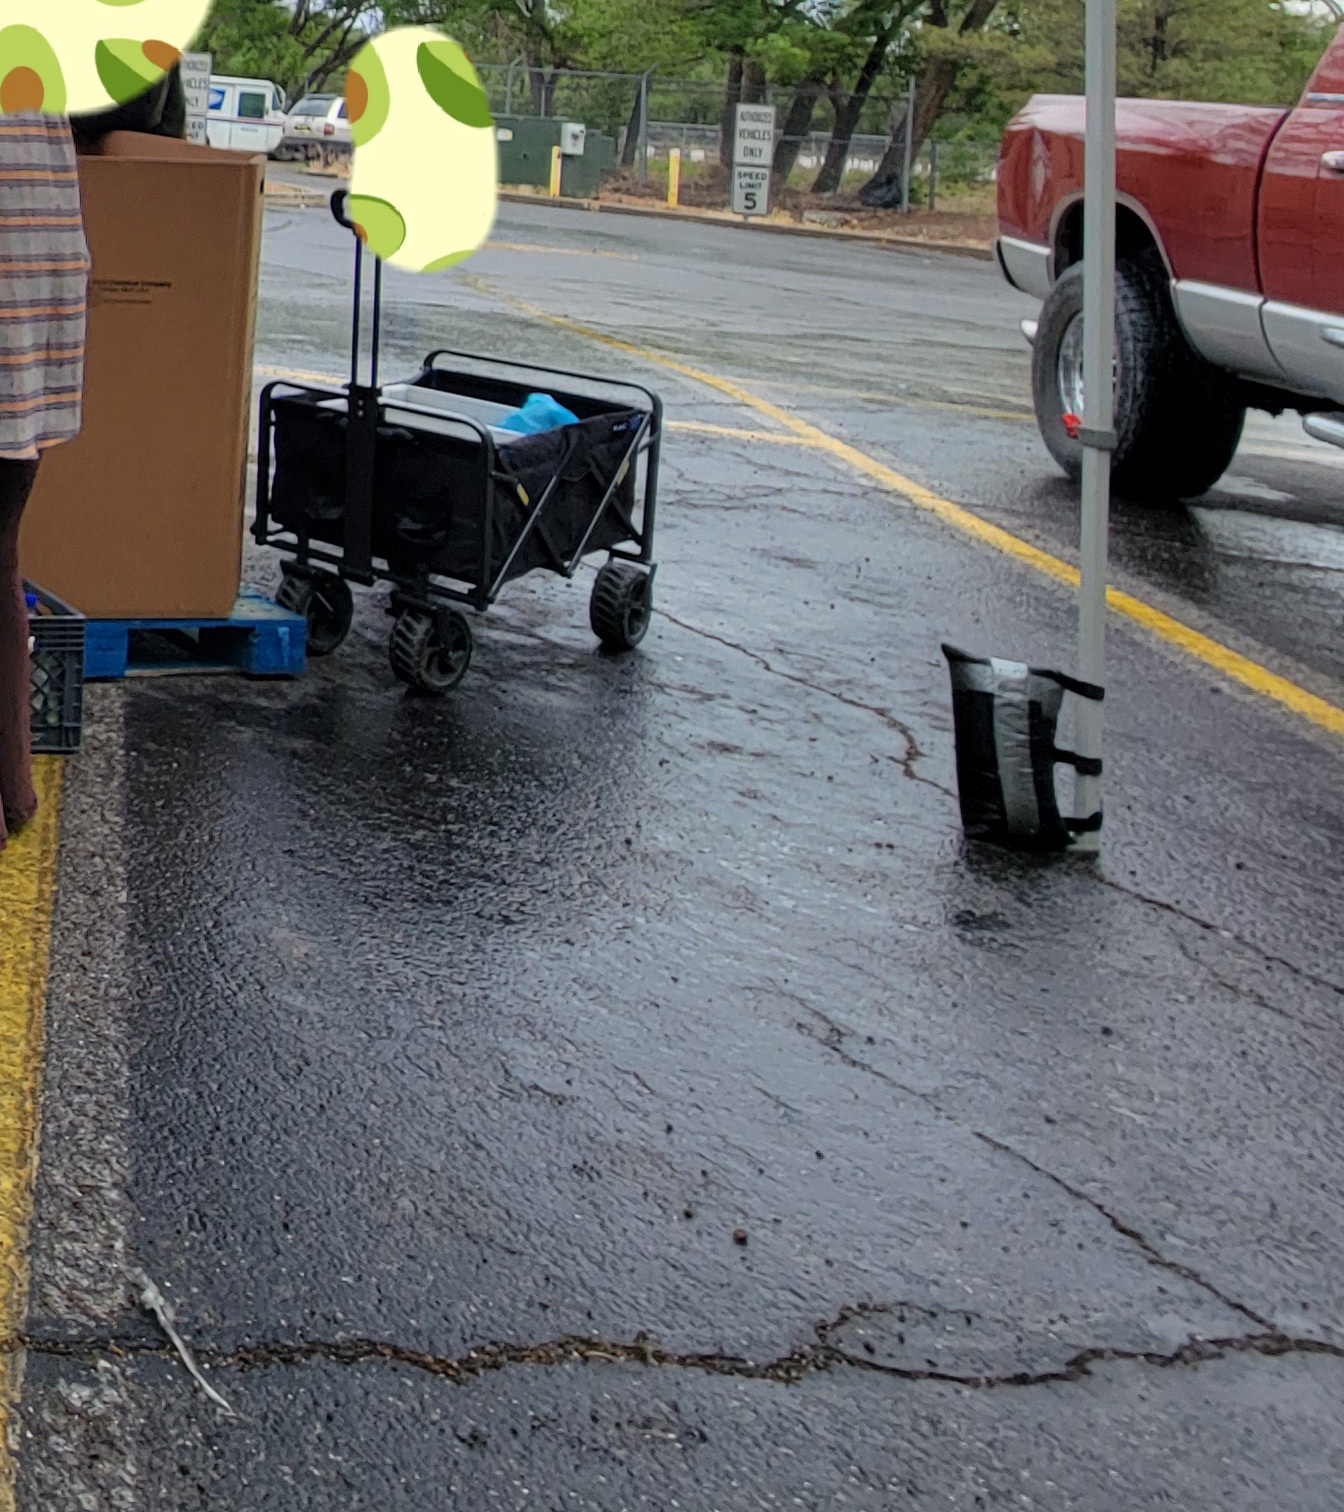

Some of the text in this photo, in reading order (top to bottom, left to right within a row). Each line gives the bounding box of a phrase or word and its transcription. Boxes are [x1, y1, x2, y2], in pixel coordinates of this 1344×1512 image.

[739, 128, 772, 141] VEHICLES
[743, 145, 763, 158] ONLY
[737, 171, 767, 181] SPEED
[739, 181, 763, 190] LIMIT
[744, 192, 758, 210] 5
